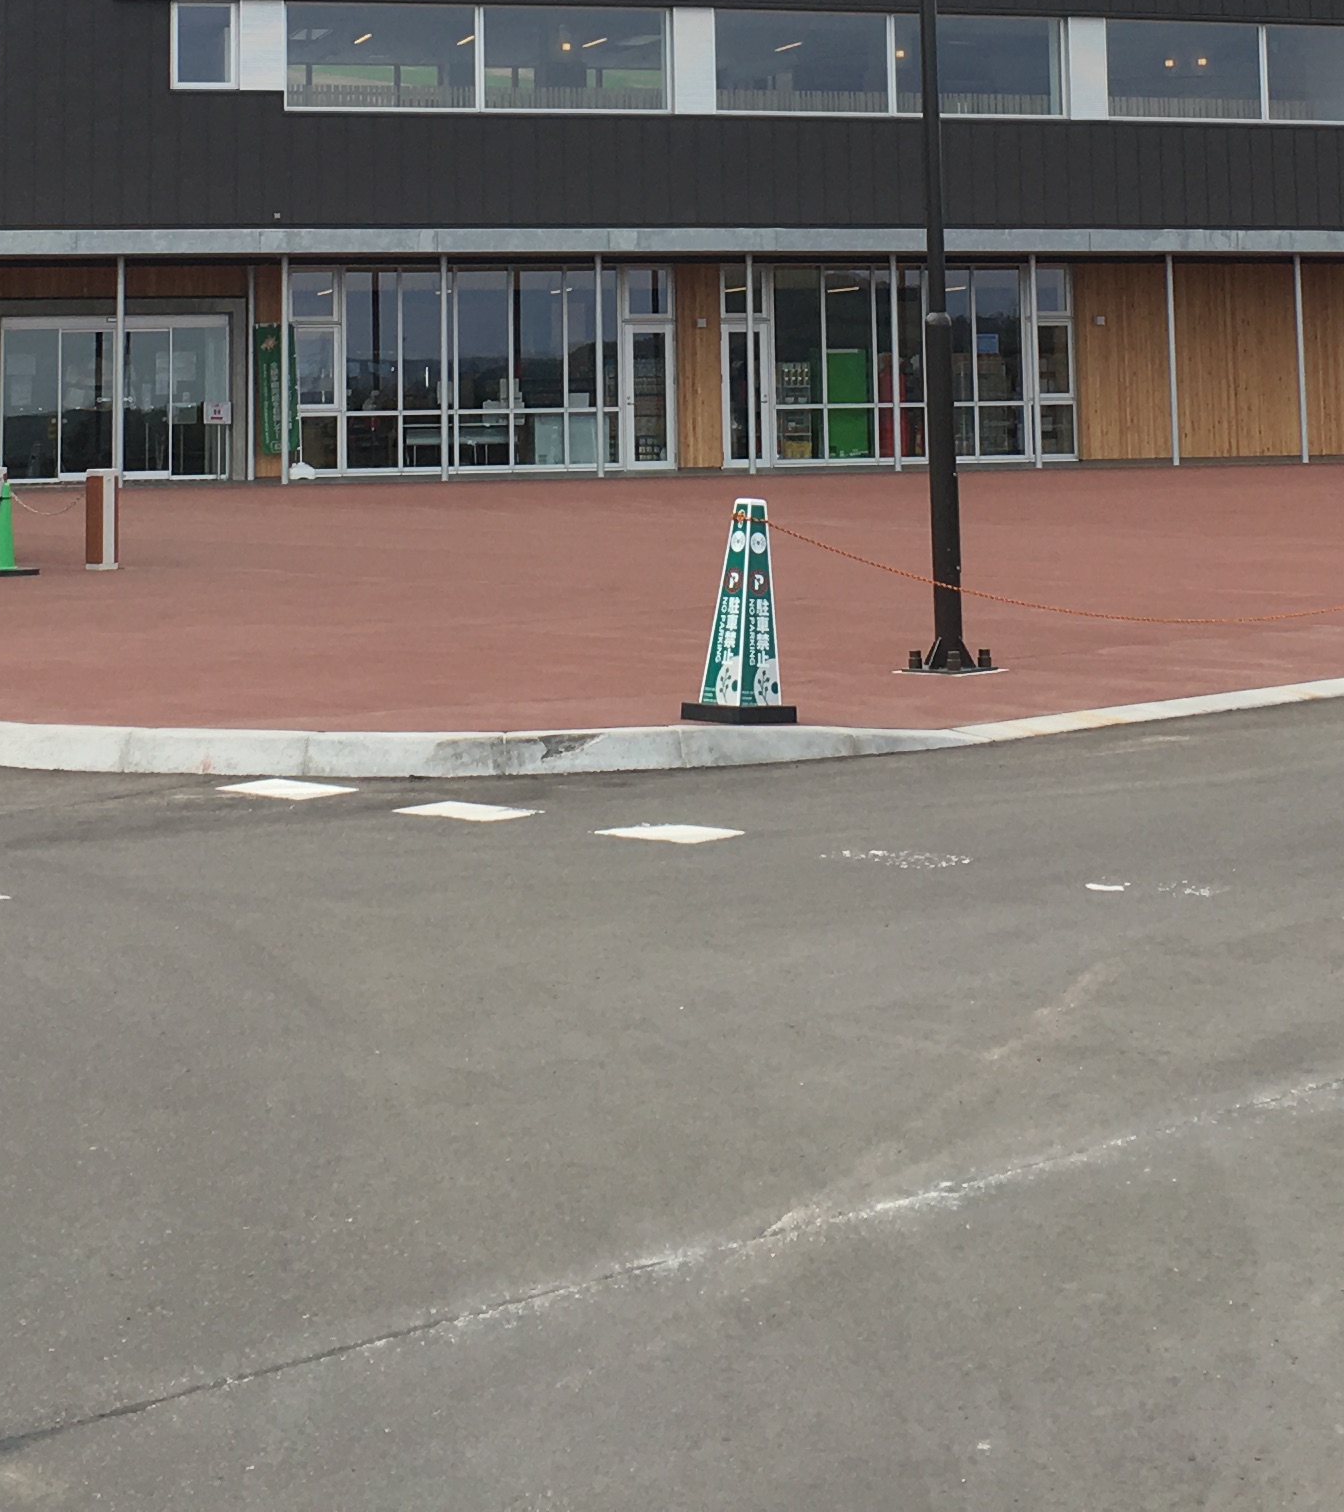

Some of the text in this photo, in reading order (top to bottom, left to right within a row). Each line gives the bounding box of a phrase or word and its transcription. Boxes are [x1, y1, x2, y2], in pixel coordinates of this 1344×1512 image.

[715, 597, 729, 663] NO PARKING
[722, 597, 740, 665] 駐車禁止
[749, 599, 756, 615] NO
[756, 599, 769, 667] 駐車禁止
